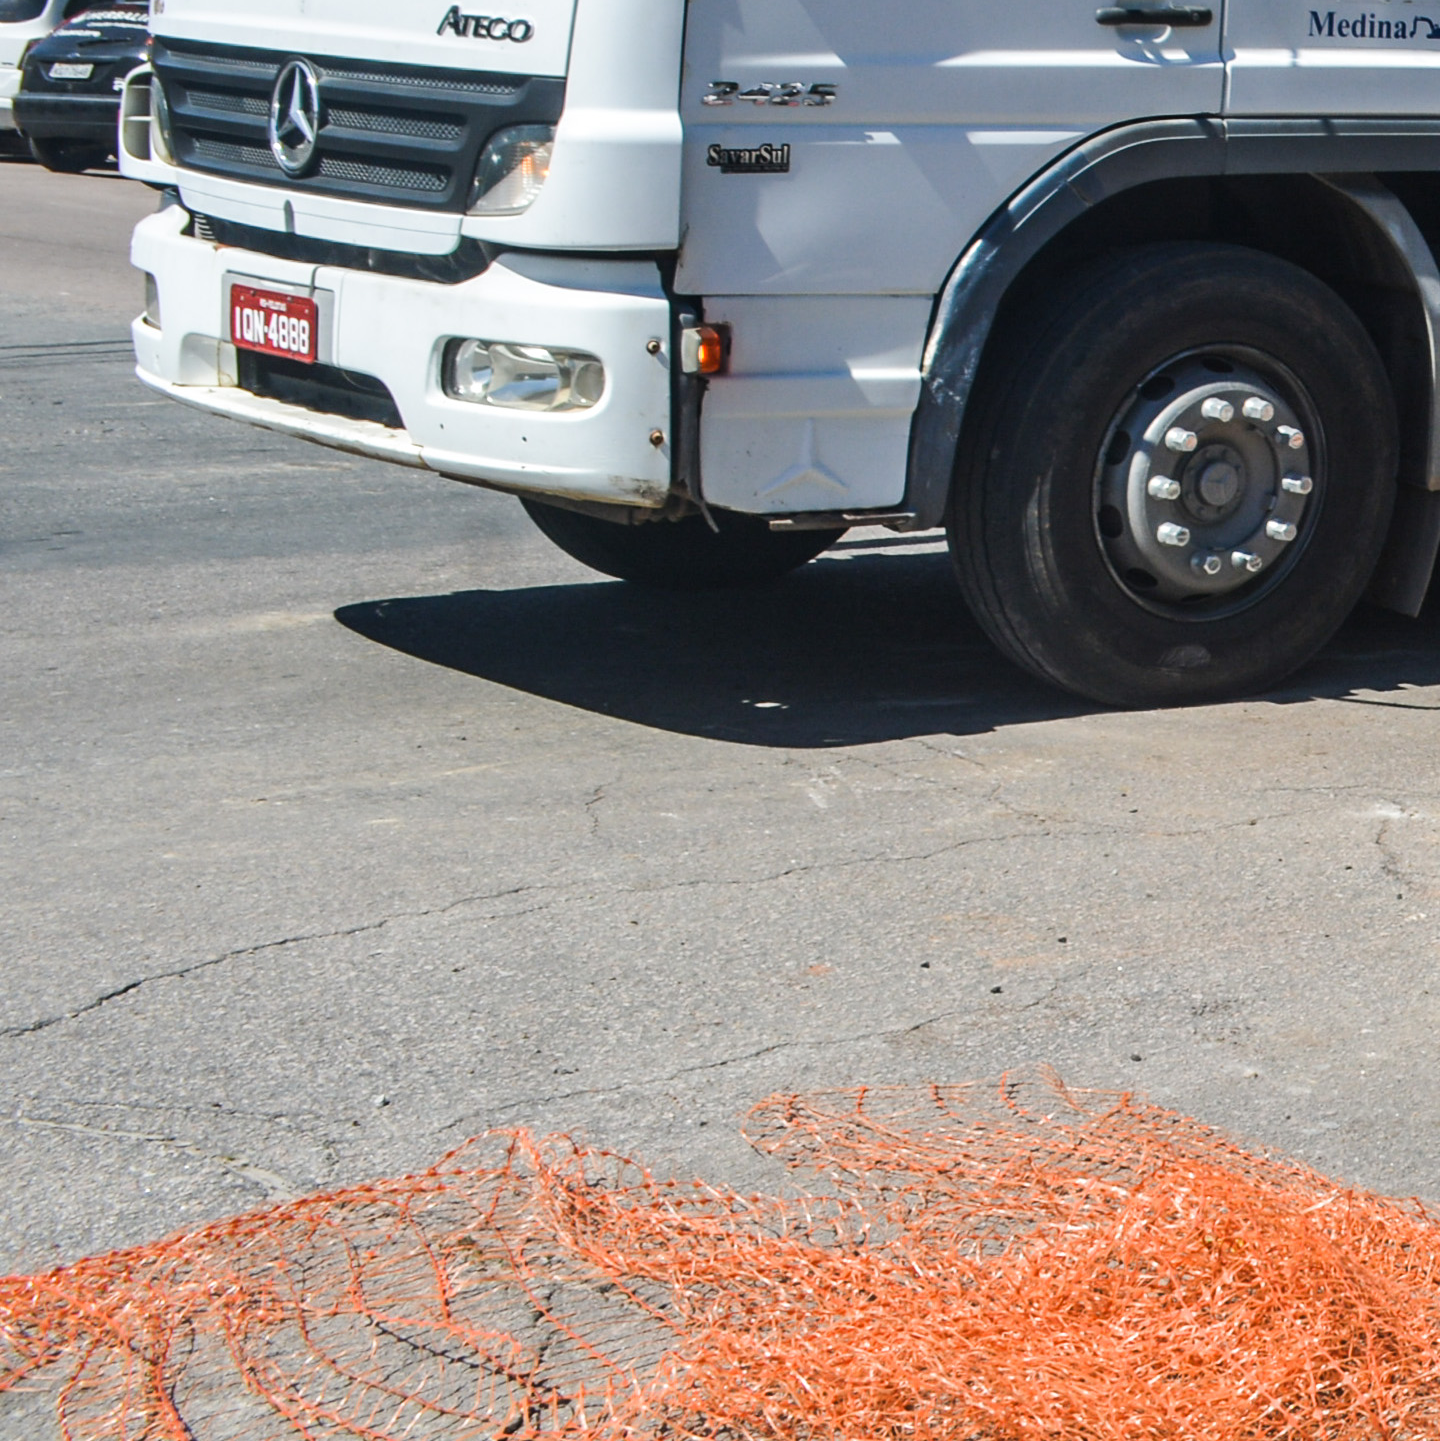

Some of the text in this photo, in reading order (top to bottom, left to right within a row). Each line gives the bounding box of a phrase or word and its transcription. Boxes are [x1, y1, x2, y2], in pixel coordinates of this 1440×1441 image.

[436, 4, 536, 44] ATEGO
[1308, 10, 1408, 40] Medina
[702, 81, 838, 107] 2425
[707, 144, 790, 166] SavarSul
